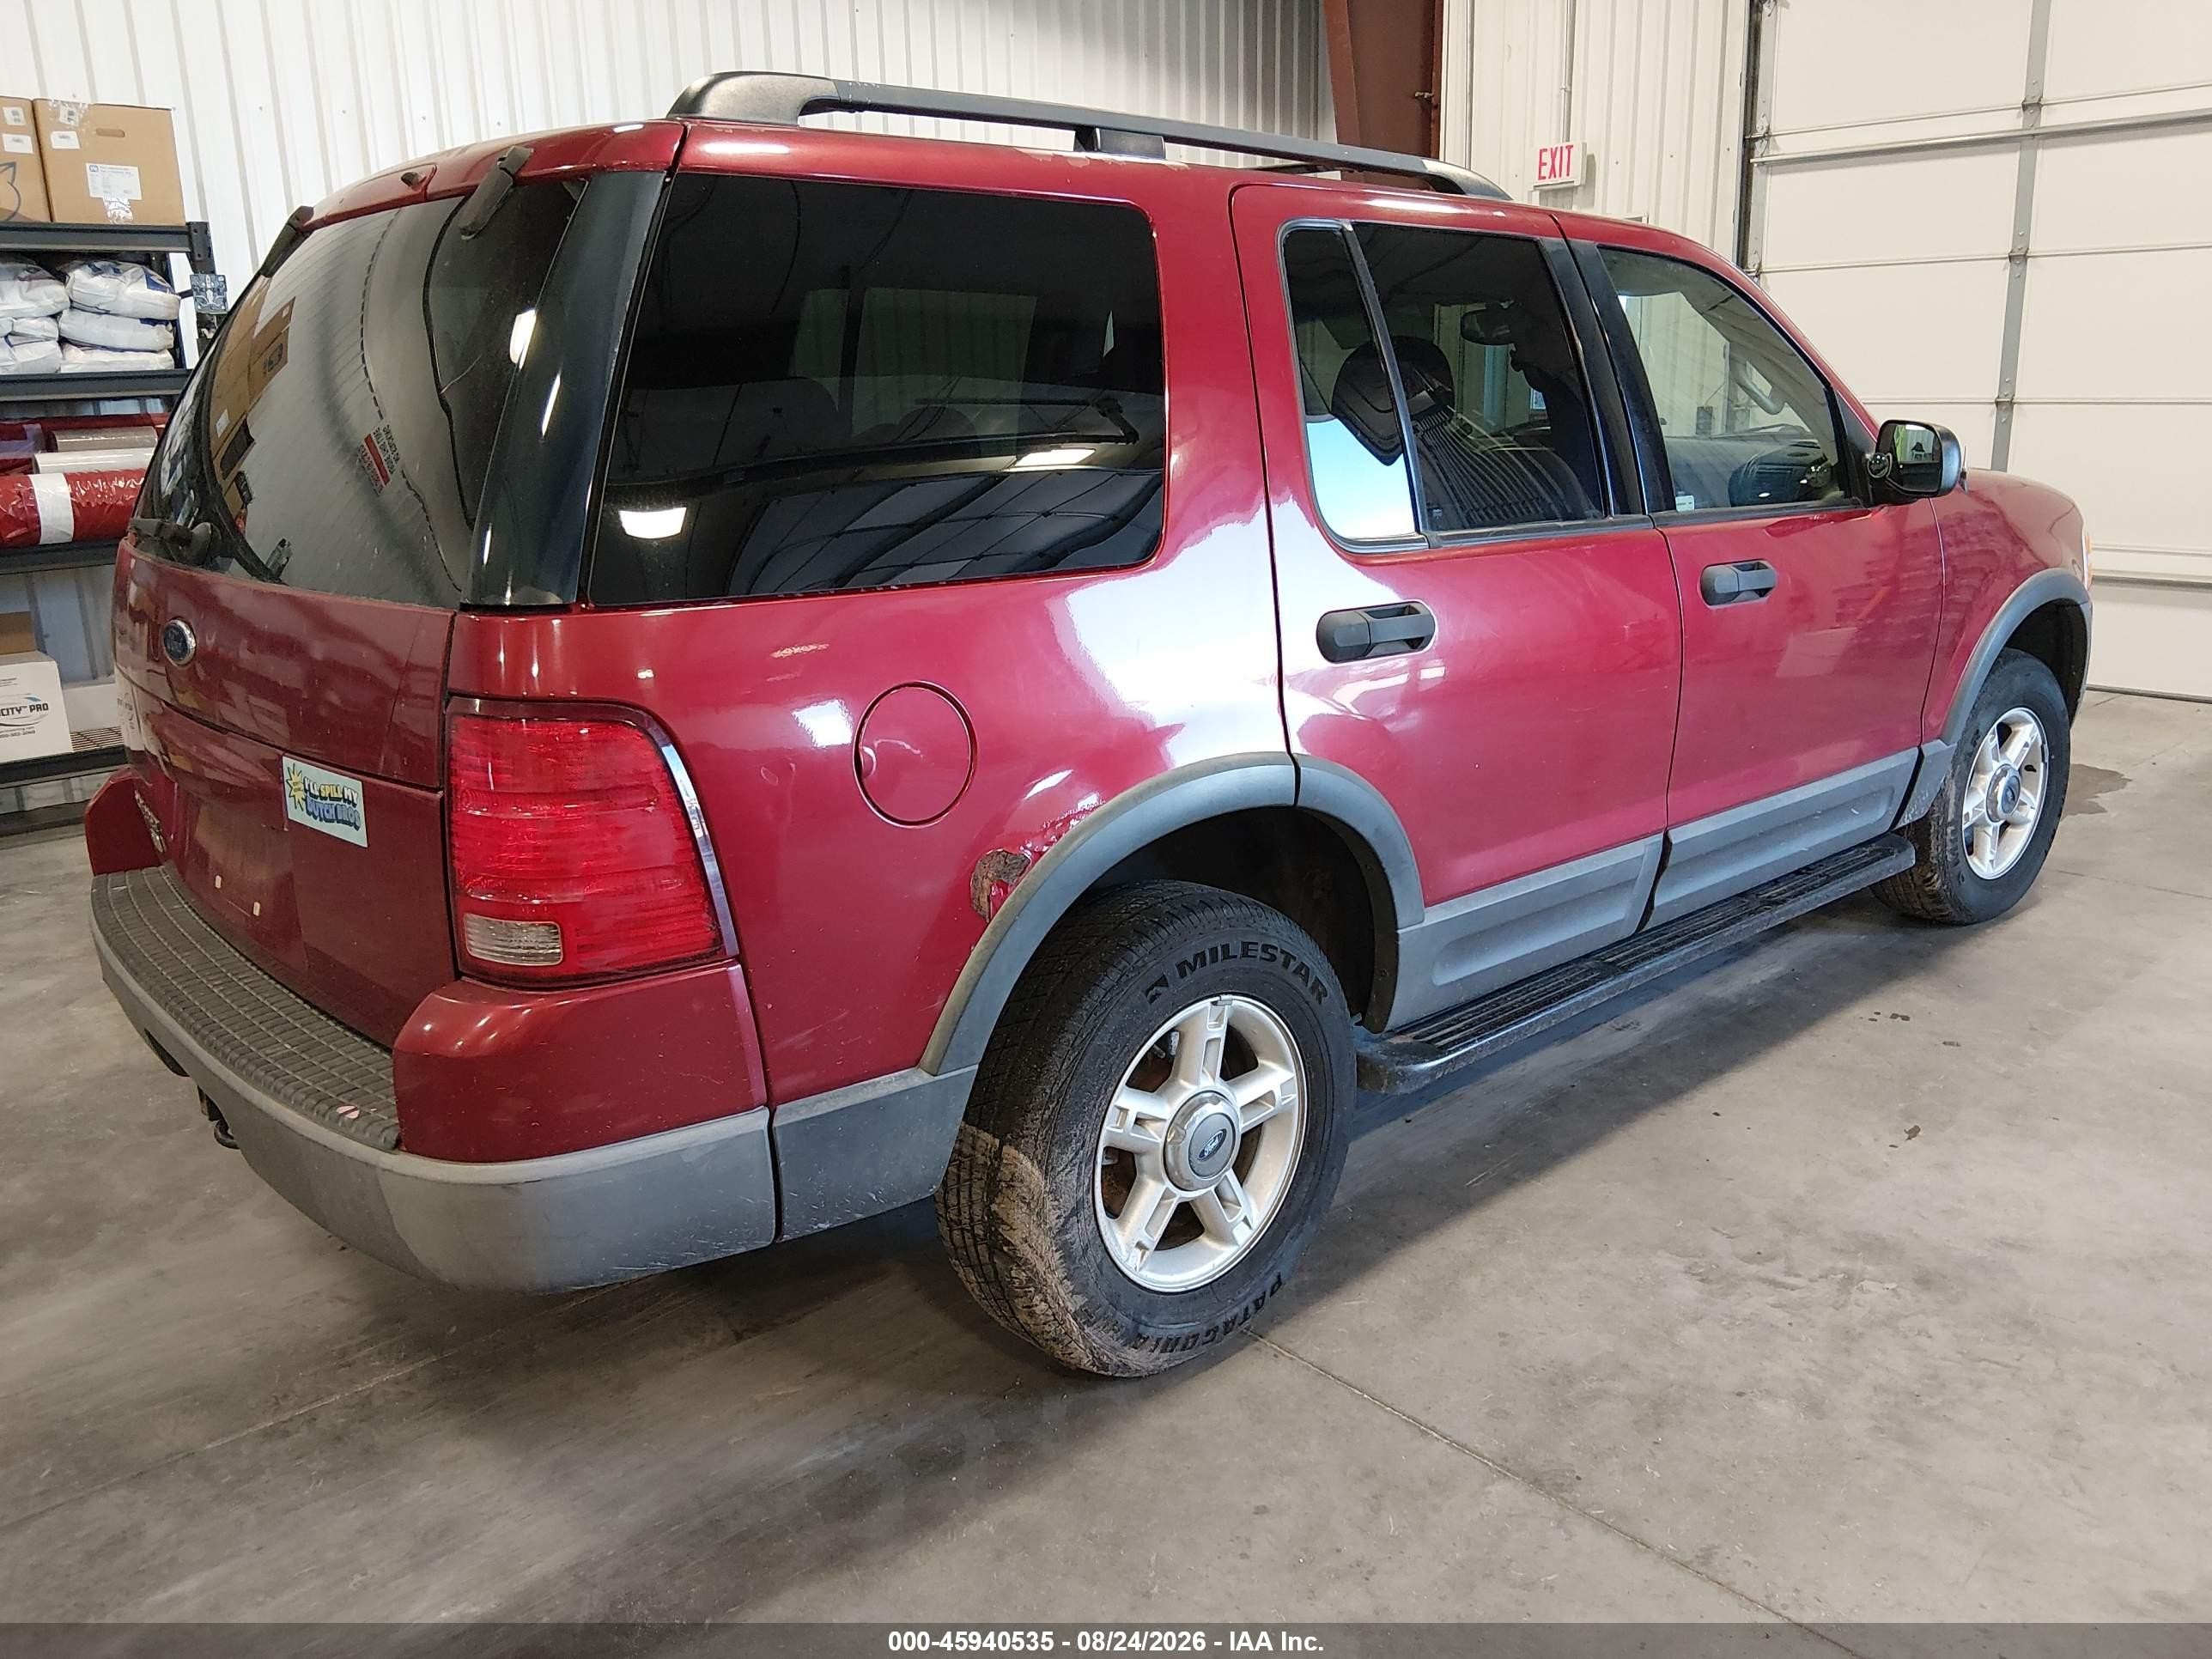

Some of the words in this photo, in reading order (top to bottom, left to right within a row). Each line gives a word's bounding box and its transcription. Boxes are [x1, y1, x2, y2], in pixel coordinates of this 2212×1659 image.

[1538, 144, 1574, 180] EXIT
[29, 702, 49, 713] PRO
[303, 776, 319, 799] I'LL
[319, 783, 343, 801] SPILL
[343, 786, 358, 808] MY
[306, 796, 336, 823] DUTCH
[1175, 941, 1328, 1006] MILESTAR
[1203, 1133, 1222, 1156] Ford
[1129, 1272, 1283, 1354] PATAGONIA
